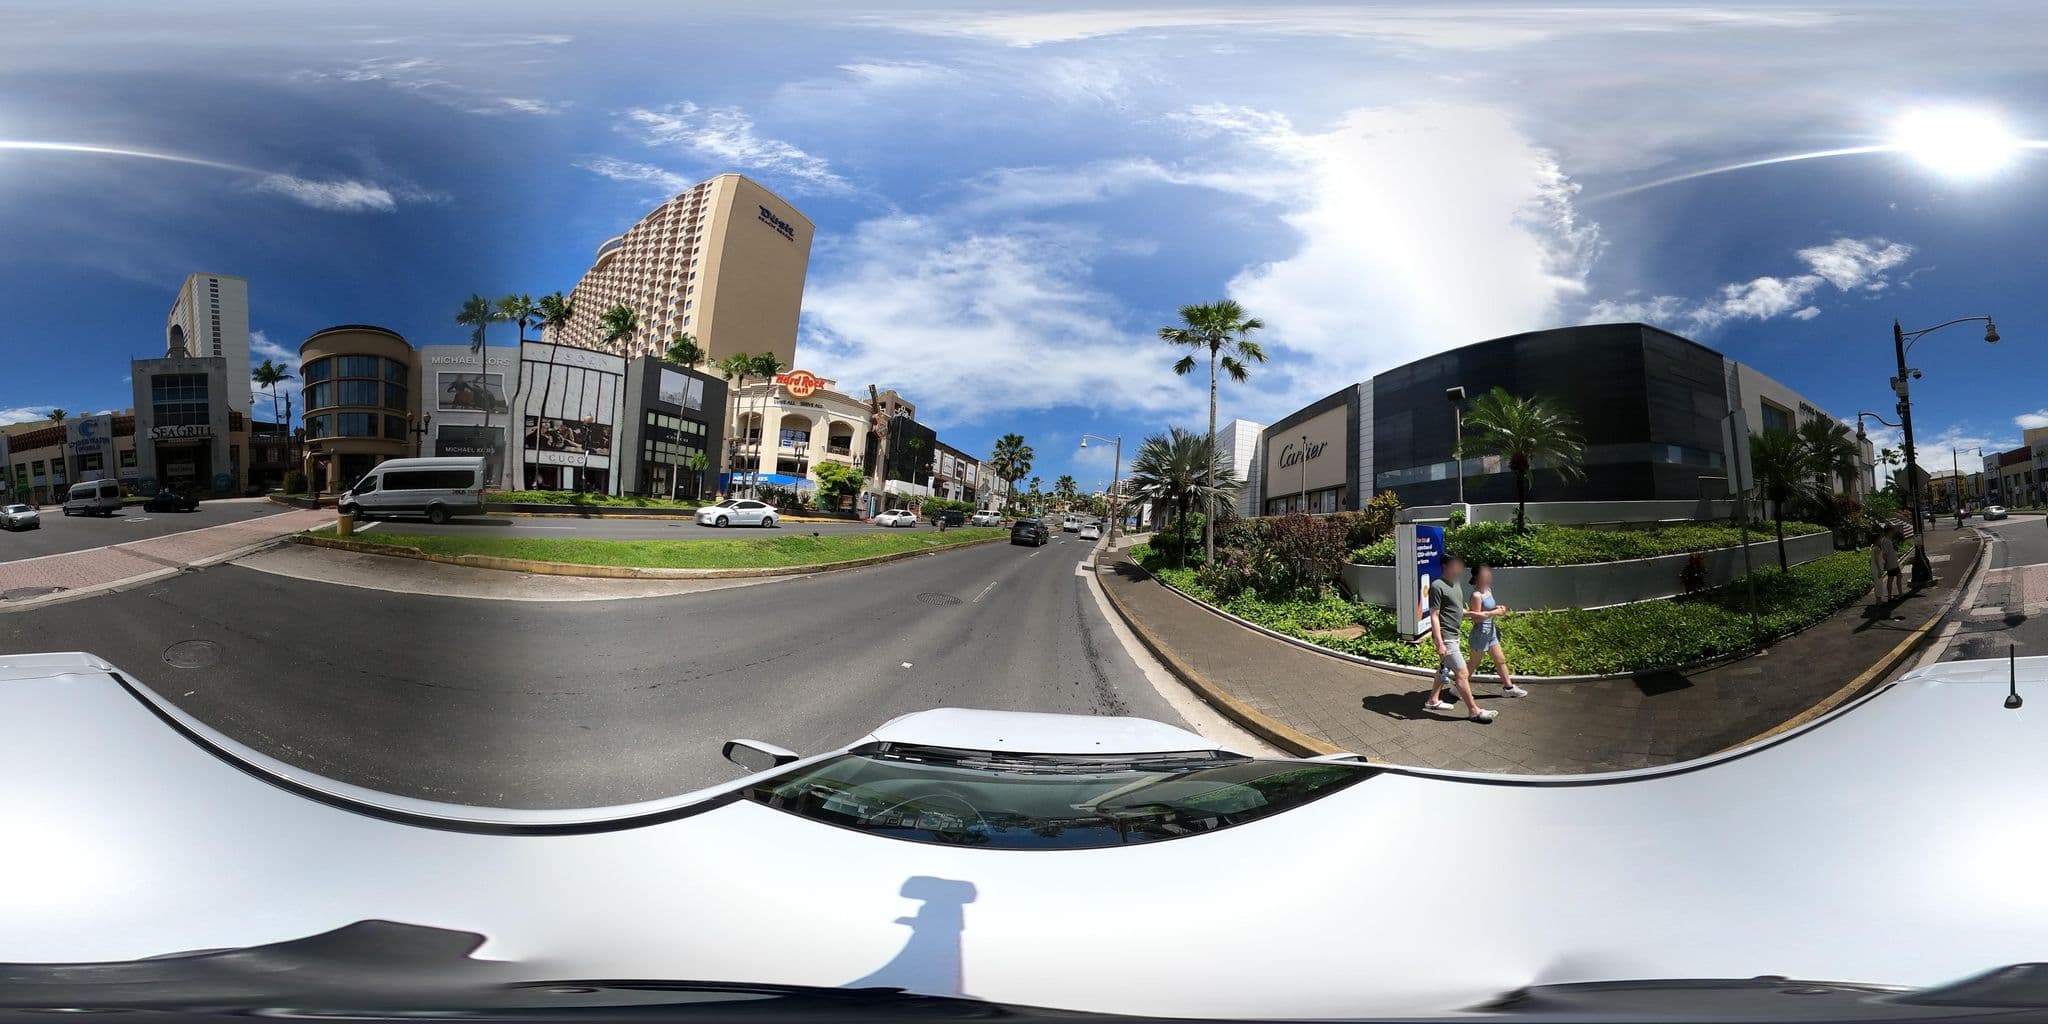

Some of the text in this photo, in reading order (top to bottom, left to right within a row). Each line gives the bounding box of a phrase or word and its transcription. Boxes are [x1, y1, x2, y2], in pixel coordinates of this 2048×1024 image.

[431, 356, 480, 365] MICHAEL
[776, 374, 827, 389] Hard Rock
[549, 454, 587, 464] GUCC
